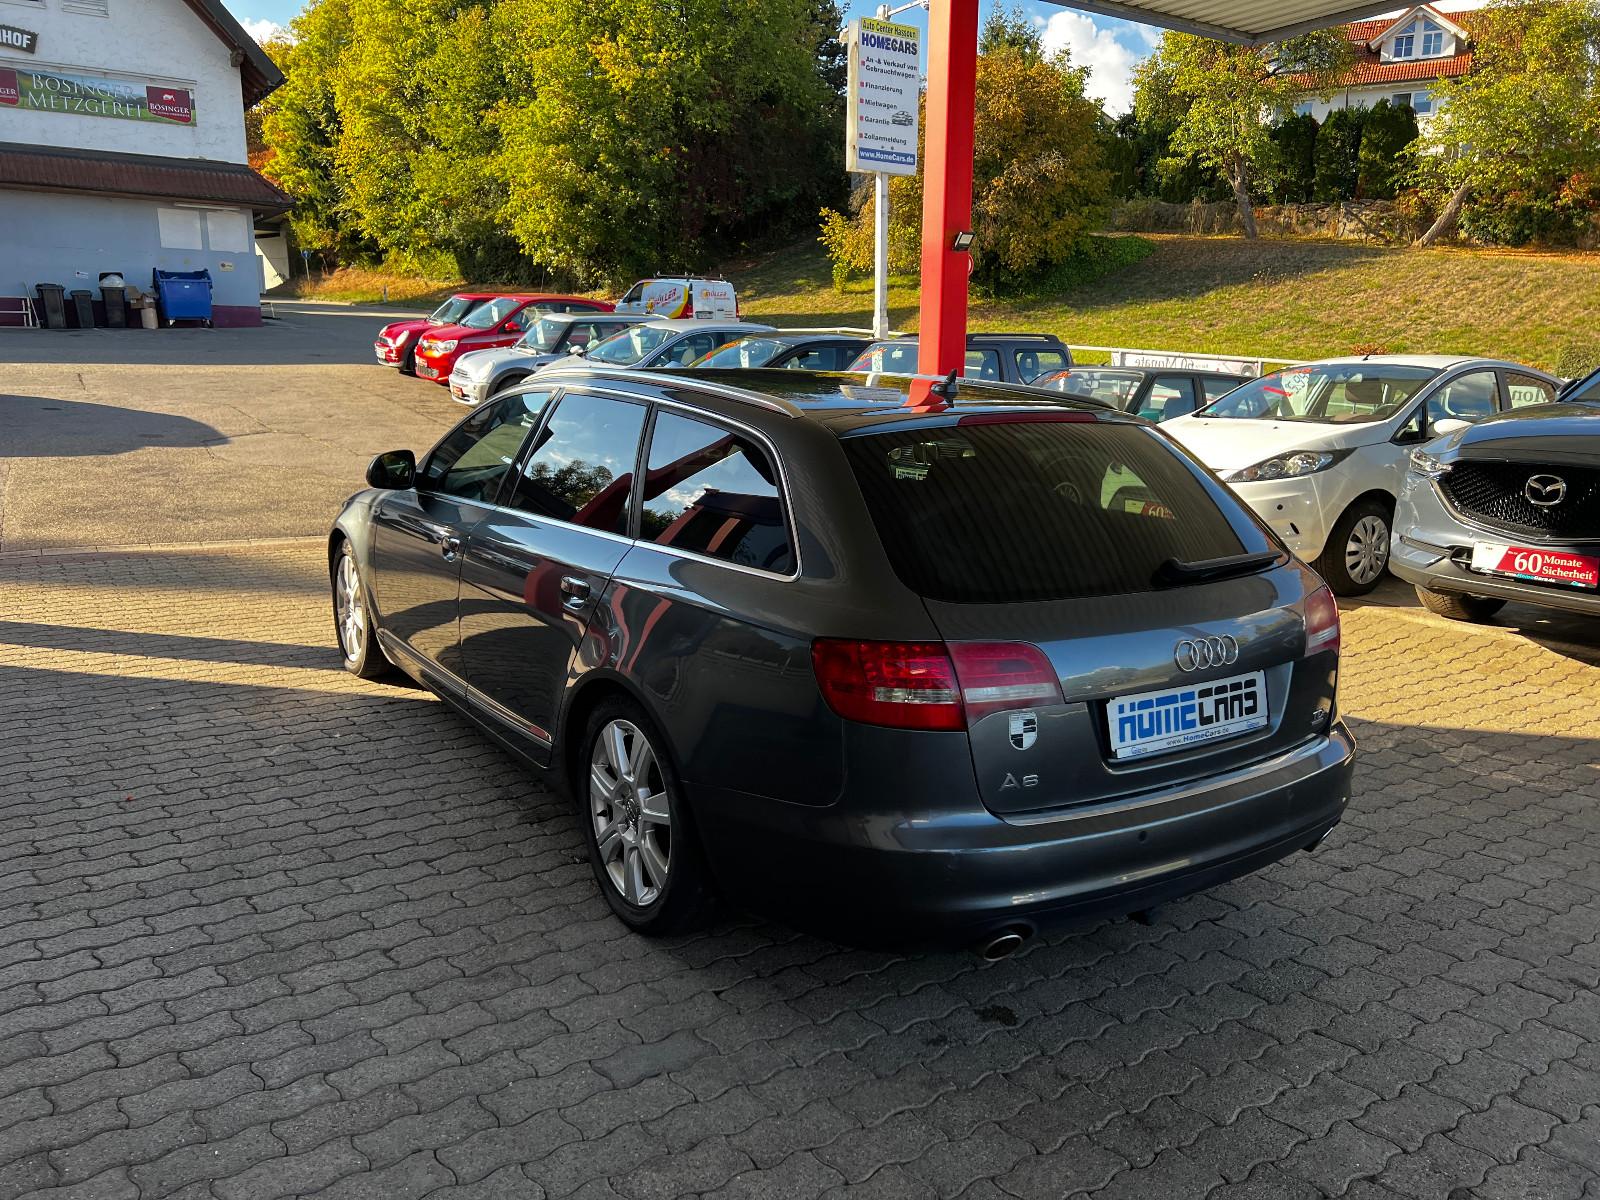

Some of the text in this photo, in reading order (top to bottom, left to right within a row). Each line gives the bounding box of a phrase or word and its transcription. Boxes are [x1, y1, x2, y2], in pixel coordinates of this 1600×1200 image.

[862, 20, 875, 30] Auto
[876, 22, 894, 34] Center
[861, 32, 918, 56] HOMECARS
[883, 58, 906, 69] Verkauf
[865, 65, 916, 79] Gebrauchtwagen
[865, 81, 903, 95] Finanzierung
[28, 90, 141, 118] METZGEREI
[865, 99, 898, 110] Mietwagen
[864, 116, 890, 126] Garantie
[864, 132, 907, 146] Zollanmeldung
[860, 151, 914, 163] www.HomeCars.de
[1514, 551, 1583, 574] 60 Monate
[1541, 566, 1593, 580] Sicherheit
[1166, 727, 1231, 747] www.HomeCars.de
[998, 773, 1039, 791] A6
